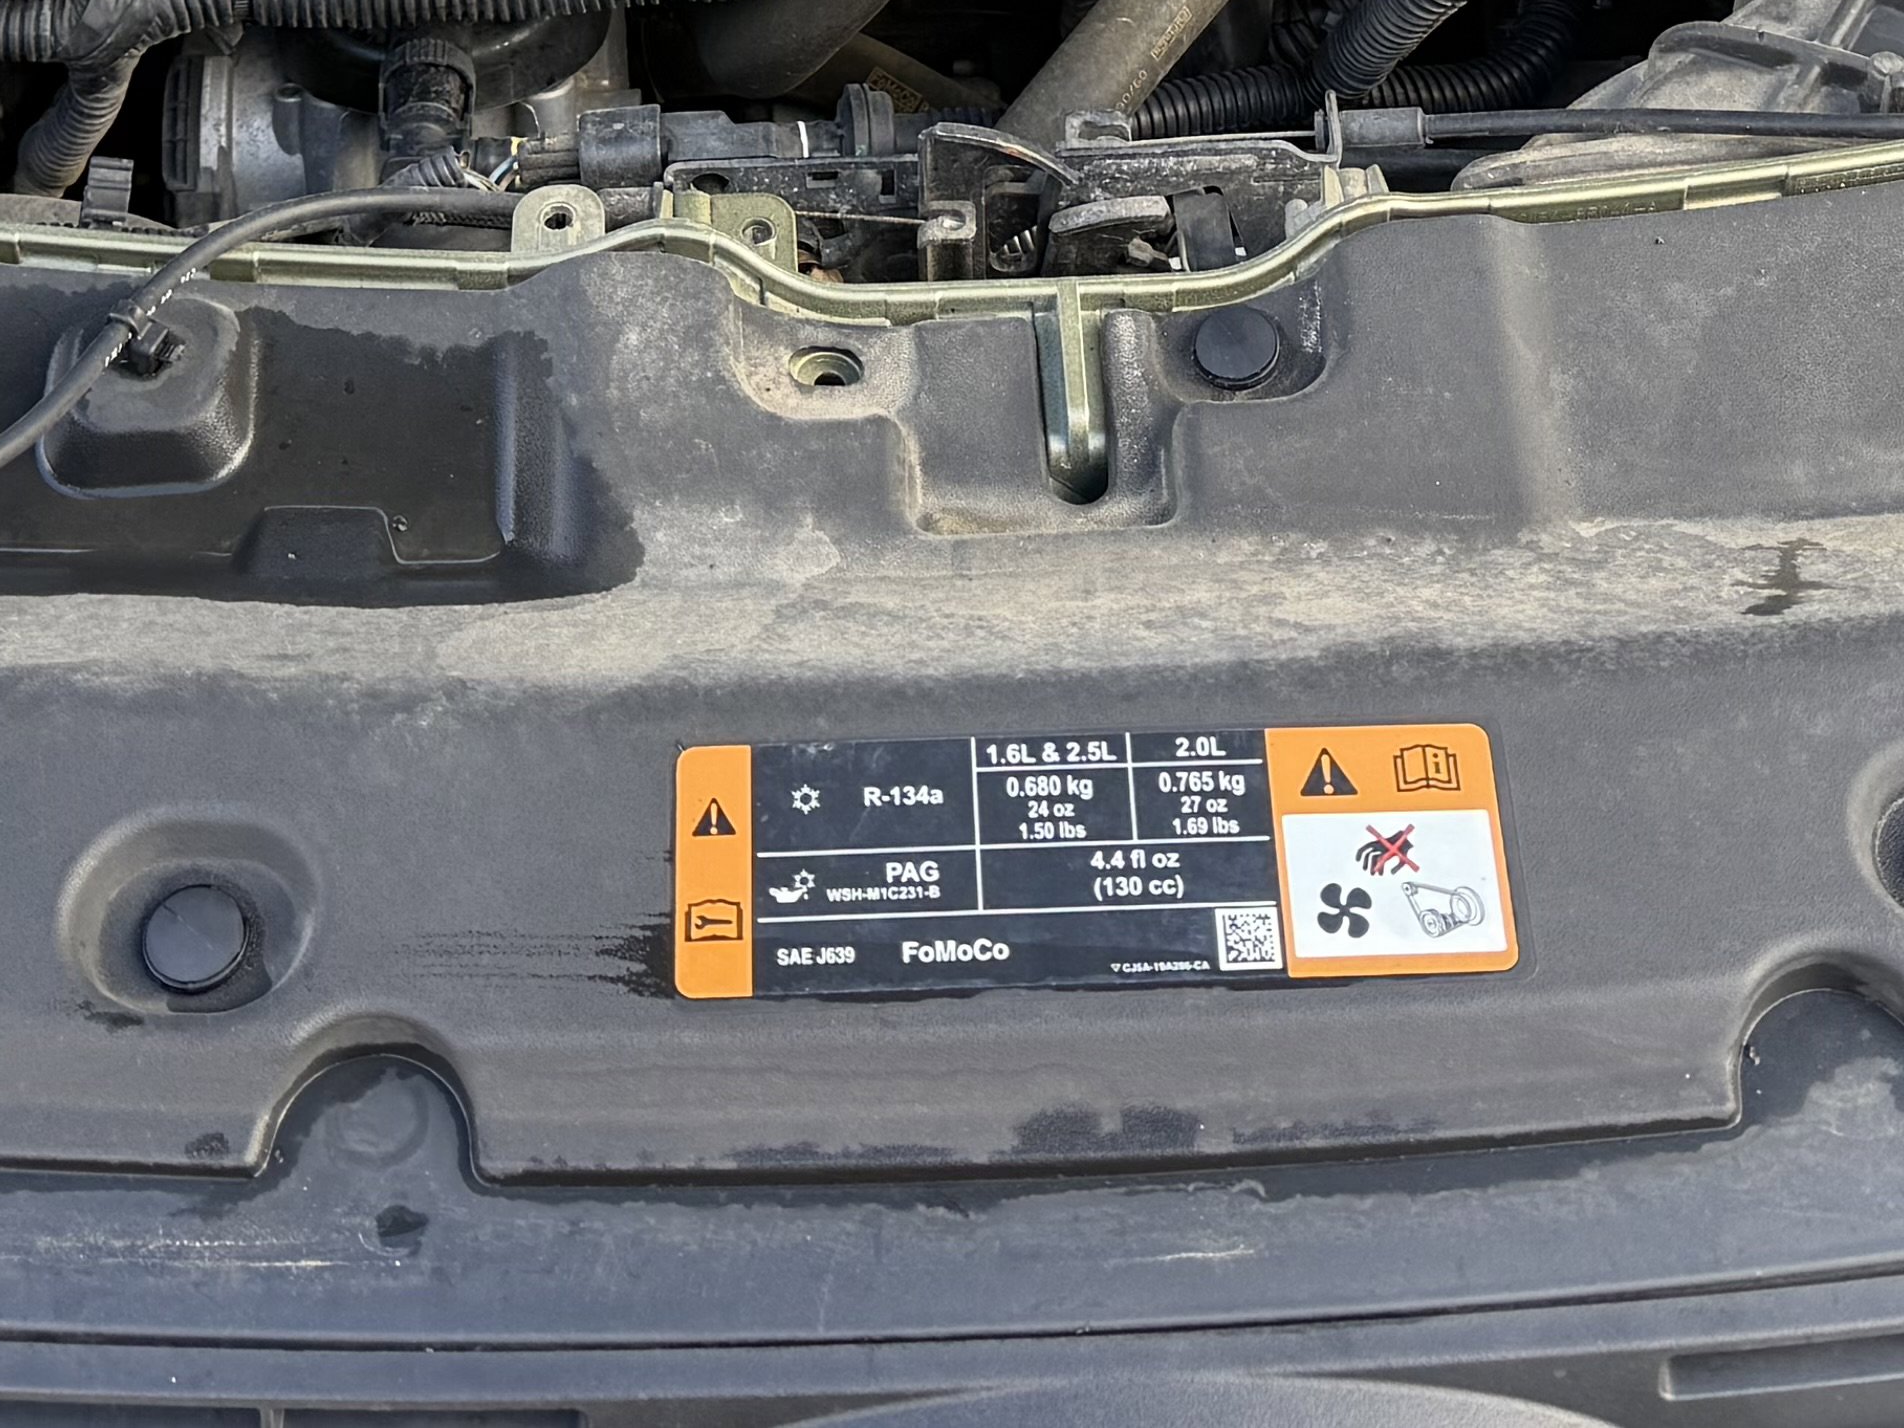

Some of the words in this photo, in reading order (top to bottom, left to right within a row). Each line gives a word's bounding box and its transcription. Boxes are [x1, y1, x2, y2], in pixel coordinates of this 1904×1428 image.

[986, 742, 1038, 764] 1.6L
[1043, 741, 1061, 762] &
[1066, 738, 1118, 762] 2.5L
[1175, 735, 1225, 758] 2.0L
[862, 783, 945, 809] R-134a
[1004, 774, 1058, 799] 0.680
[1062, 772, 1095, 803] kg
[1158, 769, 1209, 794] 0.765
[1213, 769, 1246, 798] kg
[1026, 800, 1050, 821] 24
[1053, 804, 1076, 820] oz
[1180, 796, 1203, 816] 27
[1206, 799, 1228, 815] oz
[1018, 820, 1057, 842] 1.50
[1060, 818, 1087, 840] lbs
[1172, 817, 1209, 837] 1.69
[1213, 814, 1240, 836] lbs
[885, 858, 941, 883] PAG
[1090, 850, 1124, 873] 4.4
[1130, 849, 1147, 871] fl
[1150, 852, 1181, 870] oz
[826, 885, 942, 904] WSH-M1C231-B
[1093, 875, 1141, 900] (130
[1147, 874, 1185, 899] cc)
[777, 945, 813, 967] SAE
[816, 944, 856, 966] J639
[901, 938, 1011, 966] FoMoCo
